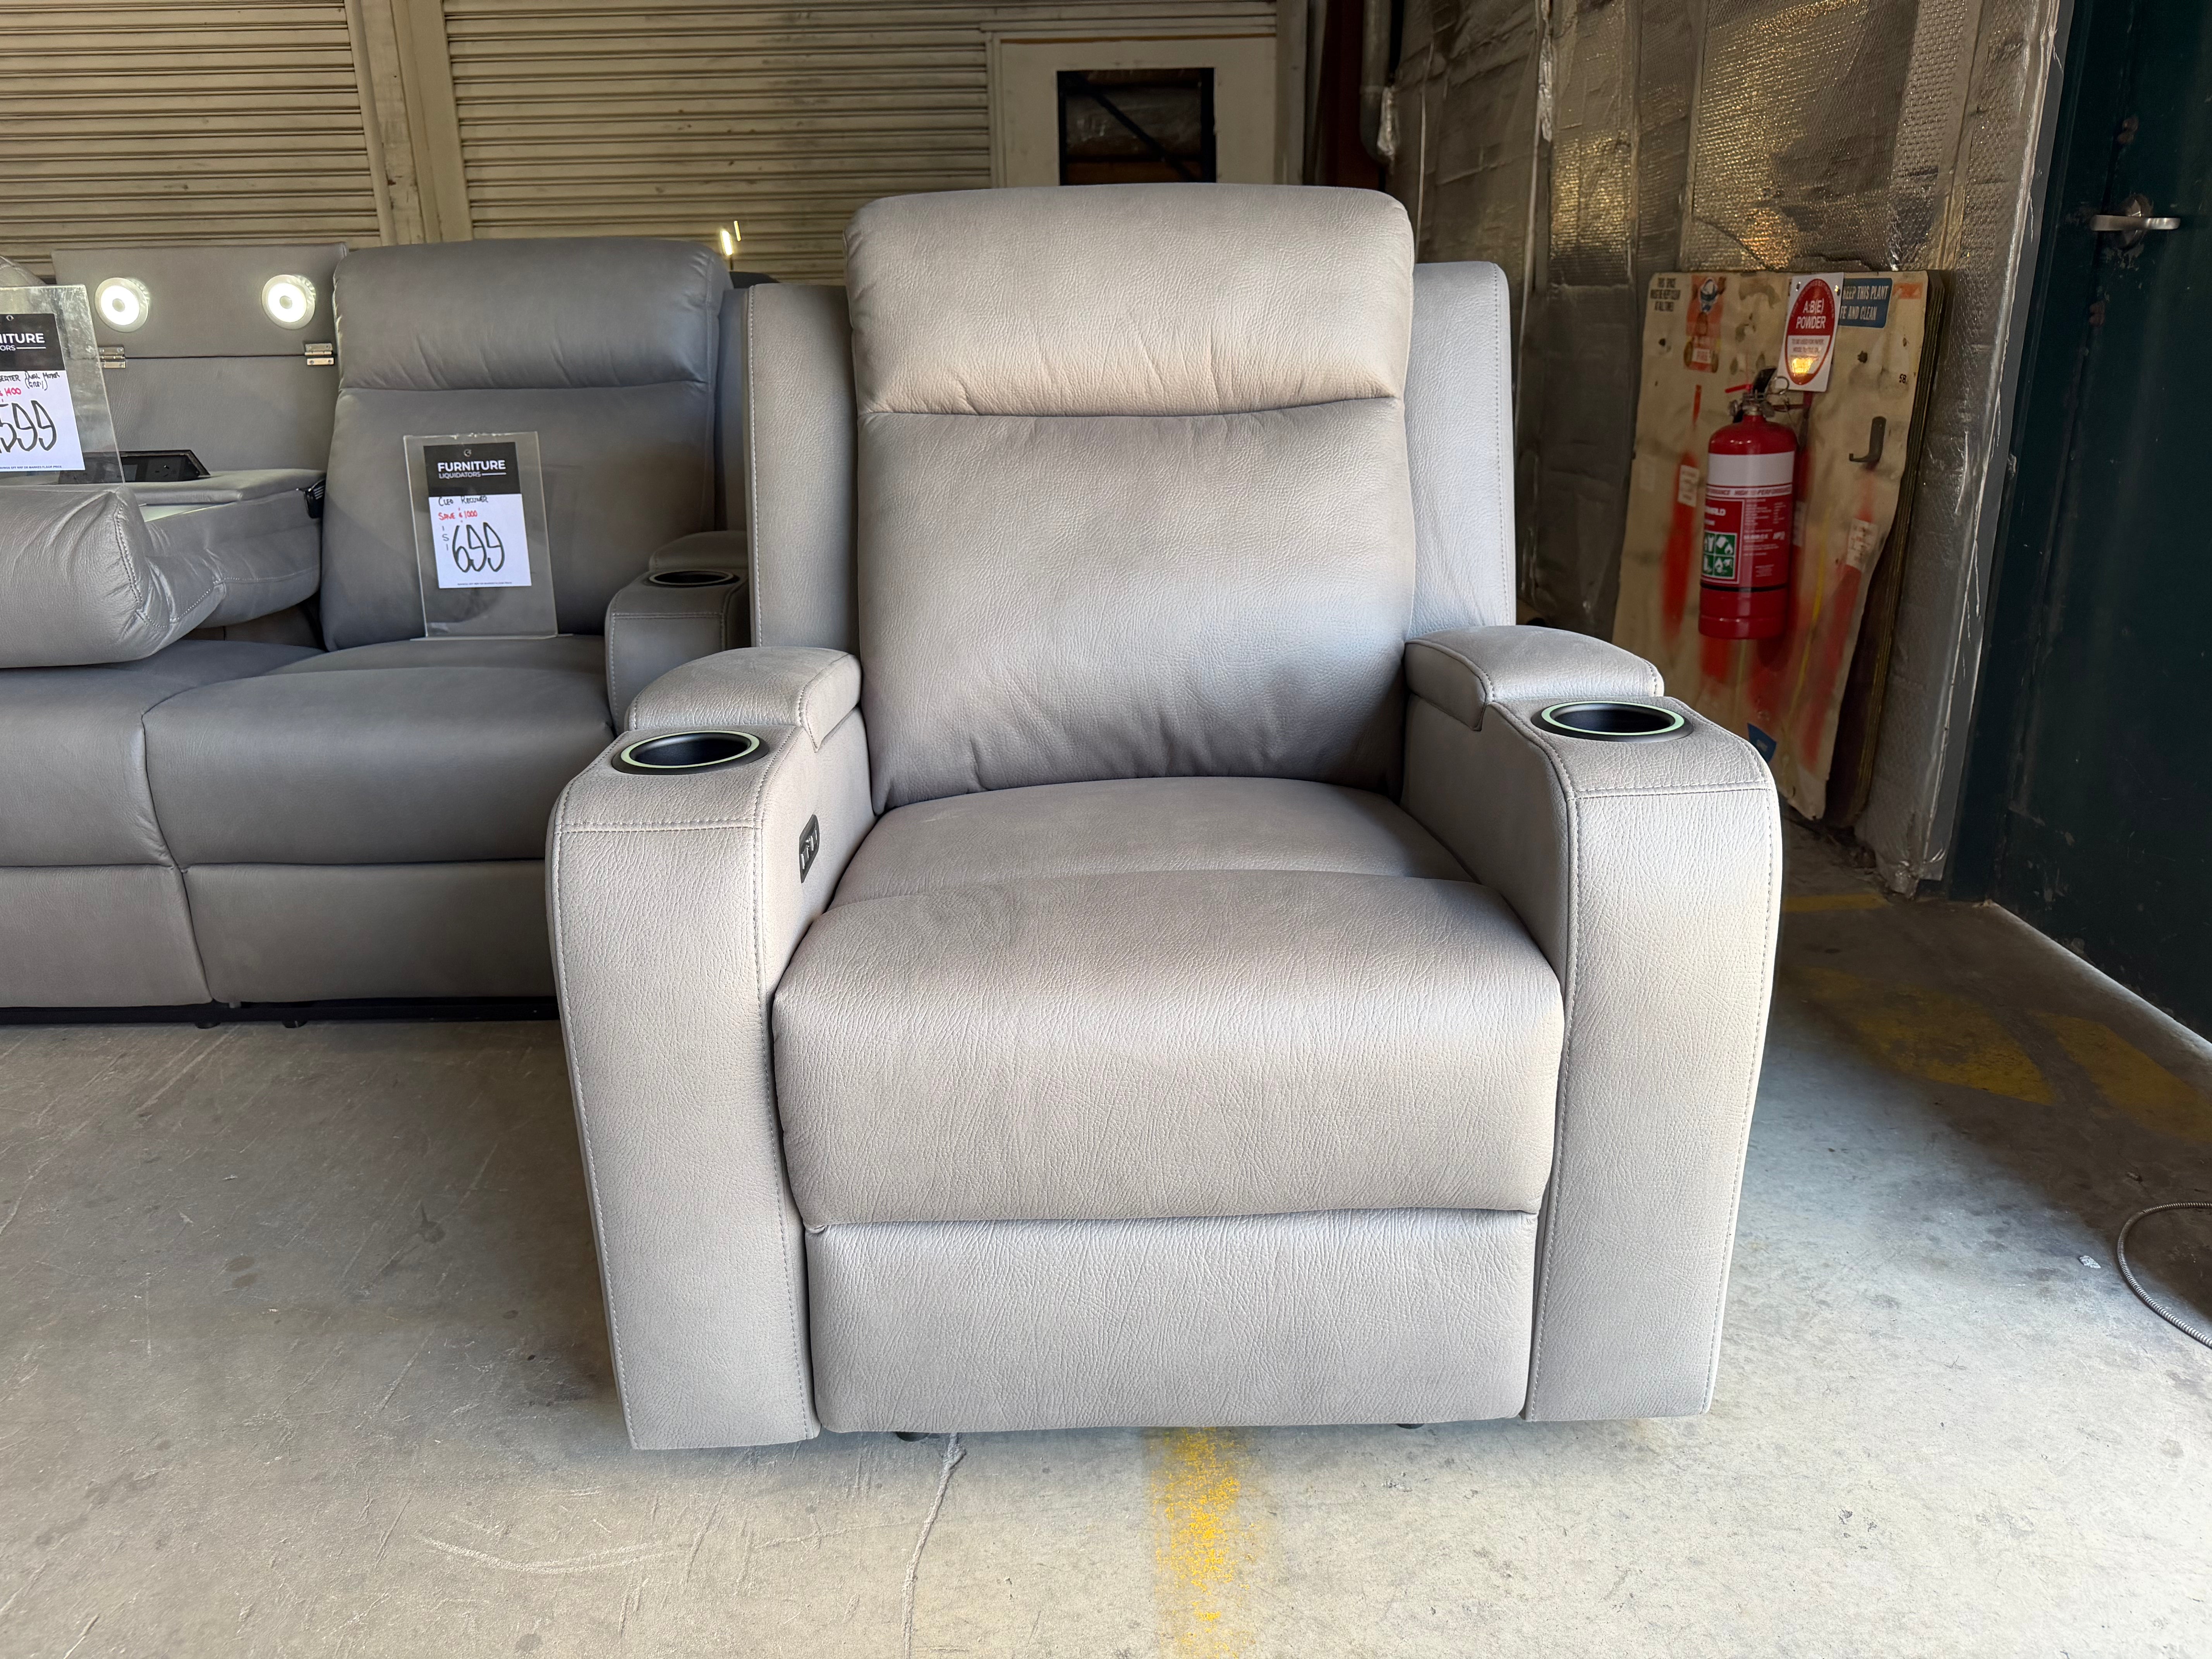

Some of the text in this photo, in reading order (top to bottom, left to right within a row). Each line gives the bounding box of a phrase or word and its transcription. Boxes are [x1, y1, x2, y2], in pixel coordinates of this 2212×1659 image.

[1857, 286, 1870, 300] THIS
[1870, 285, 1889, 300] PLANT
[1847, 306, 1859, 319] AND
[1860, 306, 1877, 320] CLEAN
[1796, 316, 1826, 329] POWDER
[0, 333, 45, 343] ITURE
[0, 400, 57, 453] 599
[438, 460, 506, 472] FURNITURE
[438, 512, 455, 520] SAVE
